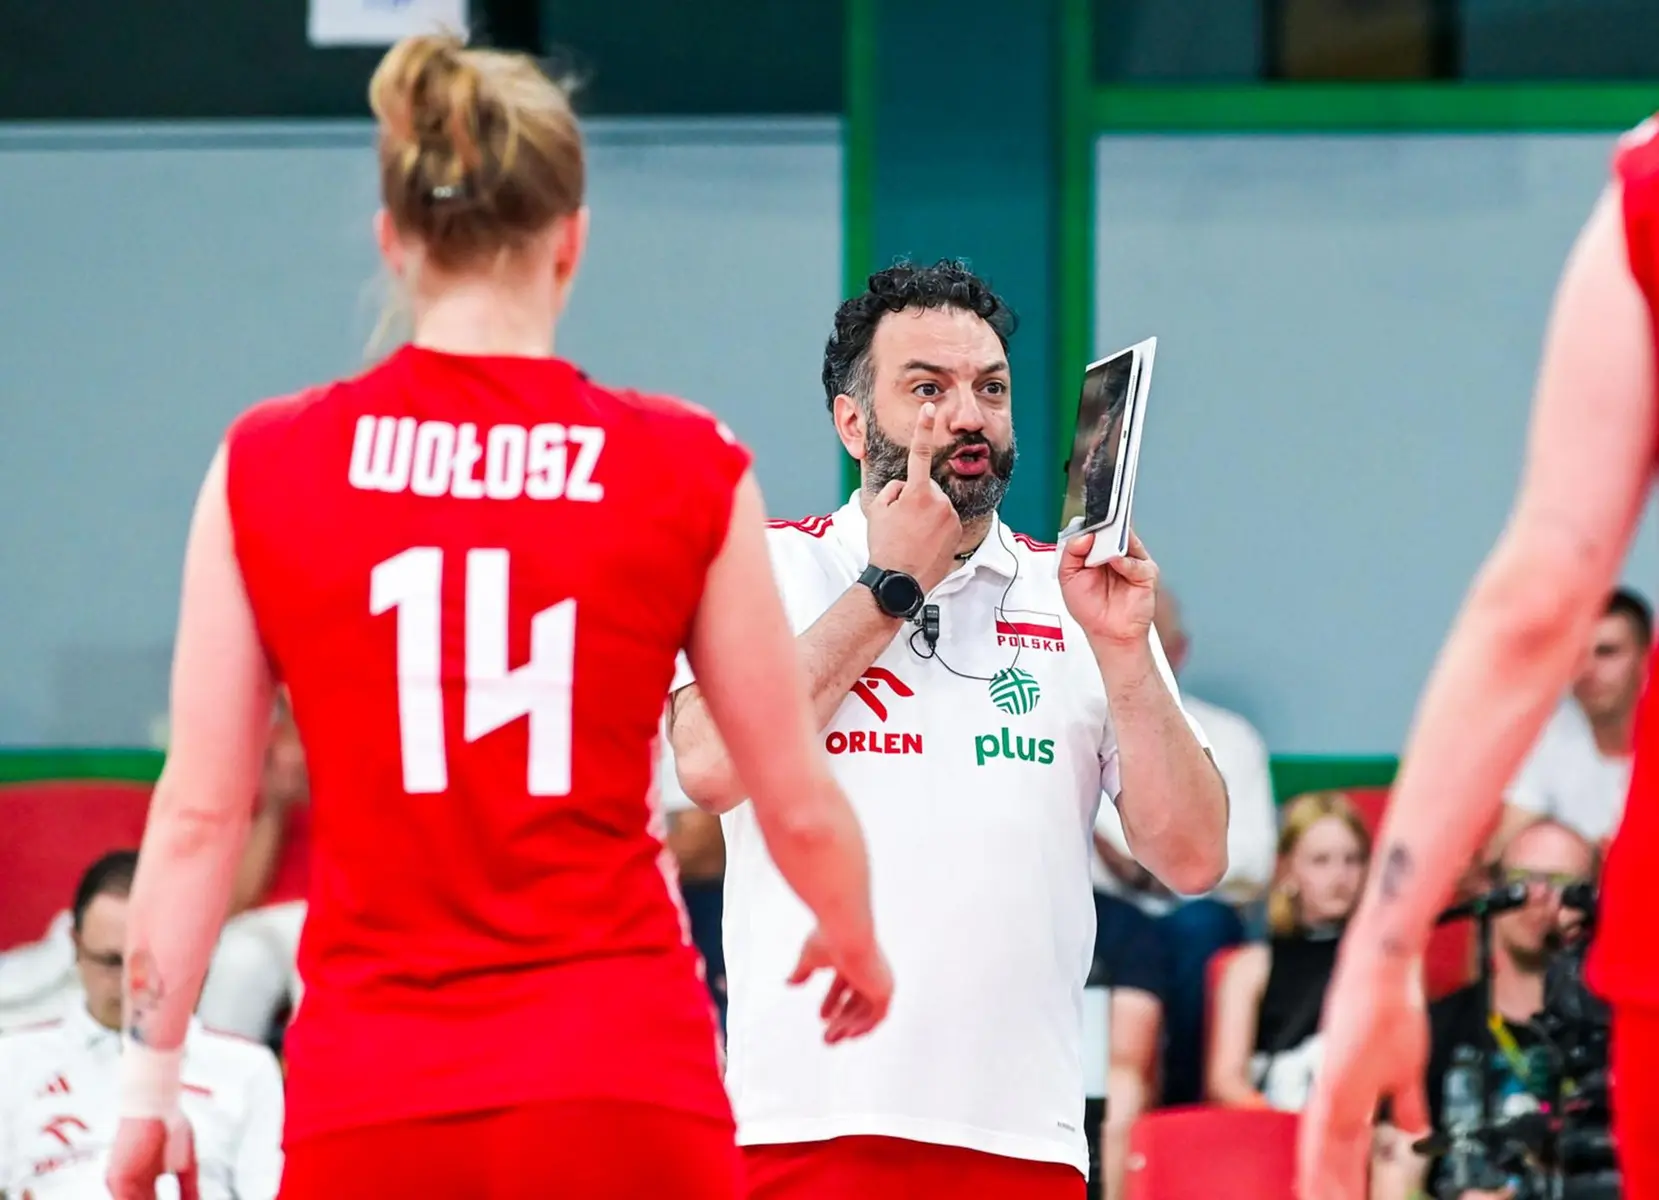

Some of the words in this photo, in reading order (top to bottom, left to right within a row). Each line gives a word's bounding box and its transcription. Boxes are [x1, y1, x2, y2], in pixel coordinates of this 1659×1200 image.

[348, 415, 605, 502] WOŁOSZ
[997, 635, 1066, 652] POLSKA
[369, 546, 577, 796] 14
[825, 731, 924, 755] ORLEN
[974, 727, 1055, 766] plus
